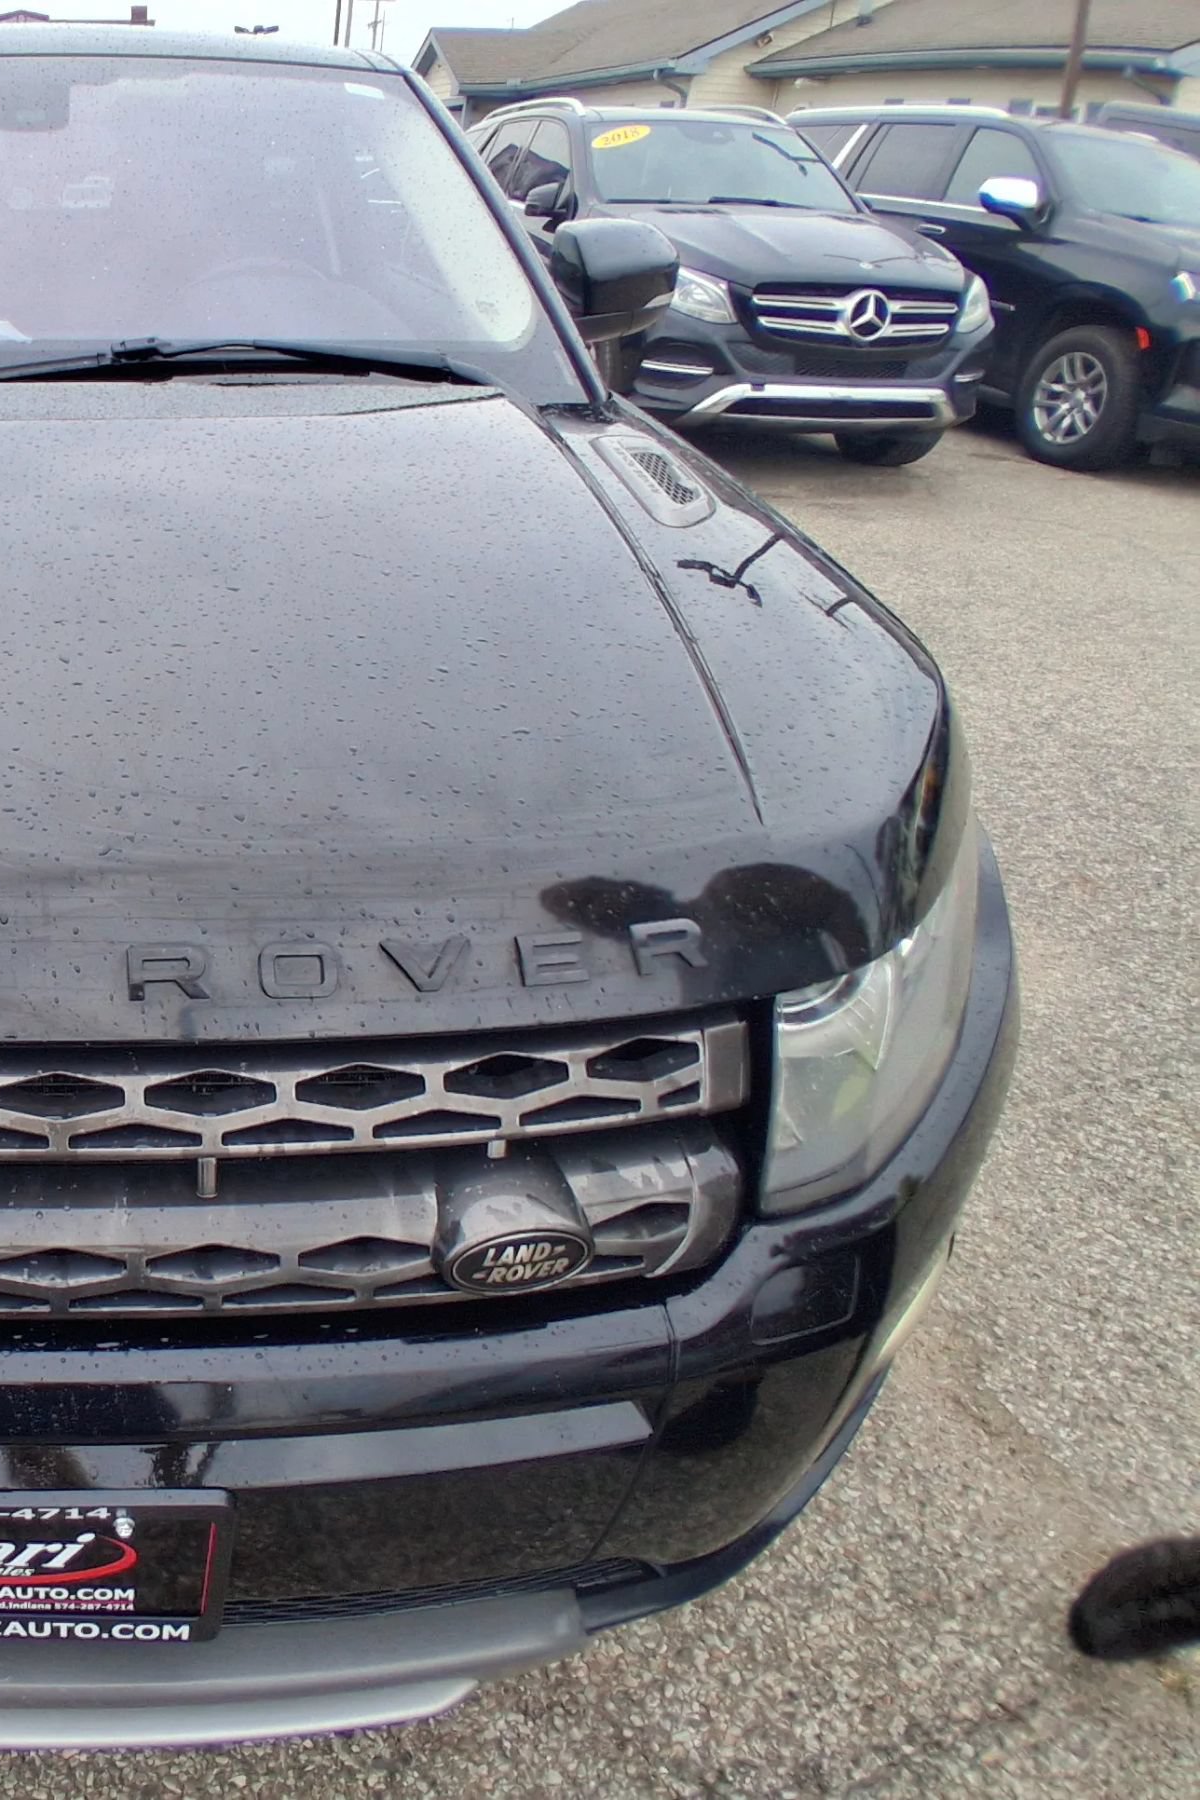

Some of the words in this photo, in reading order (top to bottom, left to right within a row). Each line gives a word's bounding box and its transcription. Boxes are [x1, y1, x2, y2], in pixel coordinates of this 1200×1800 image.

[602, 128, 640, 145] 2018
[126, 918, 708, 1002] ROVER
[483, 1242, 552, 1267] LAND
[486, 1257, 569, 1284] ROVER
